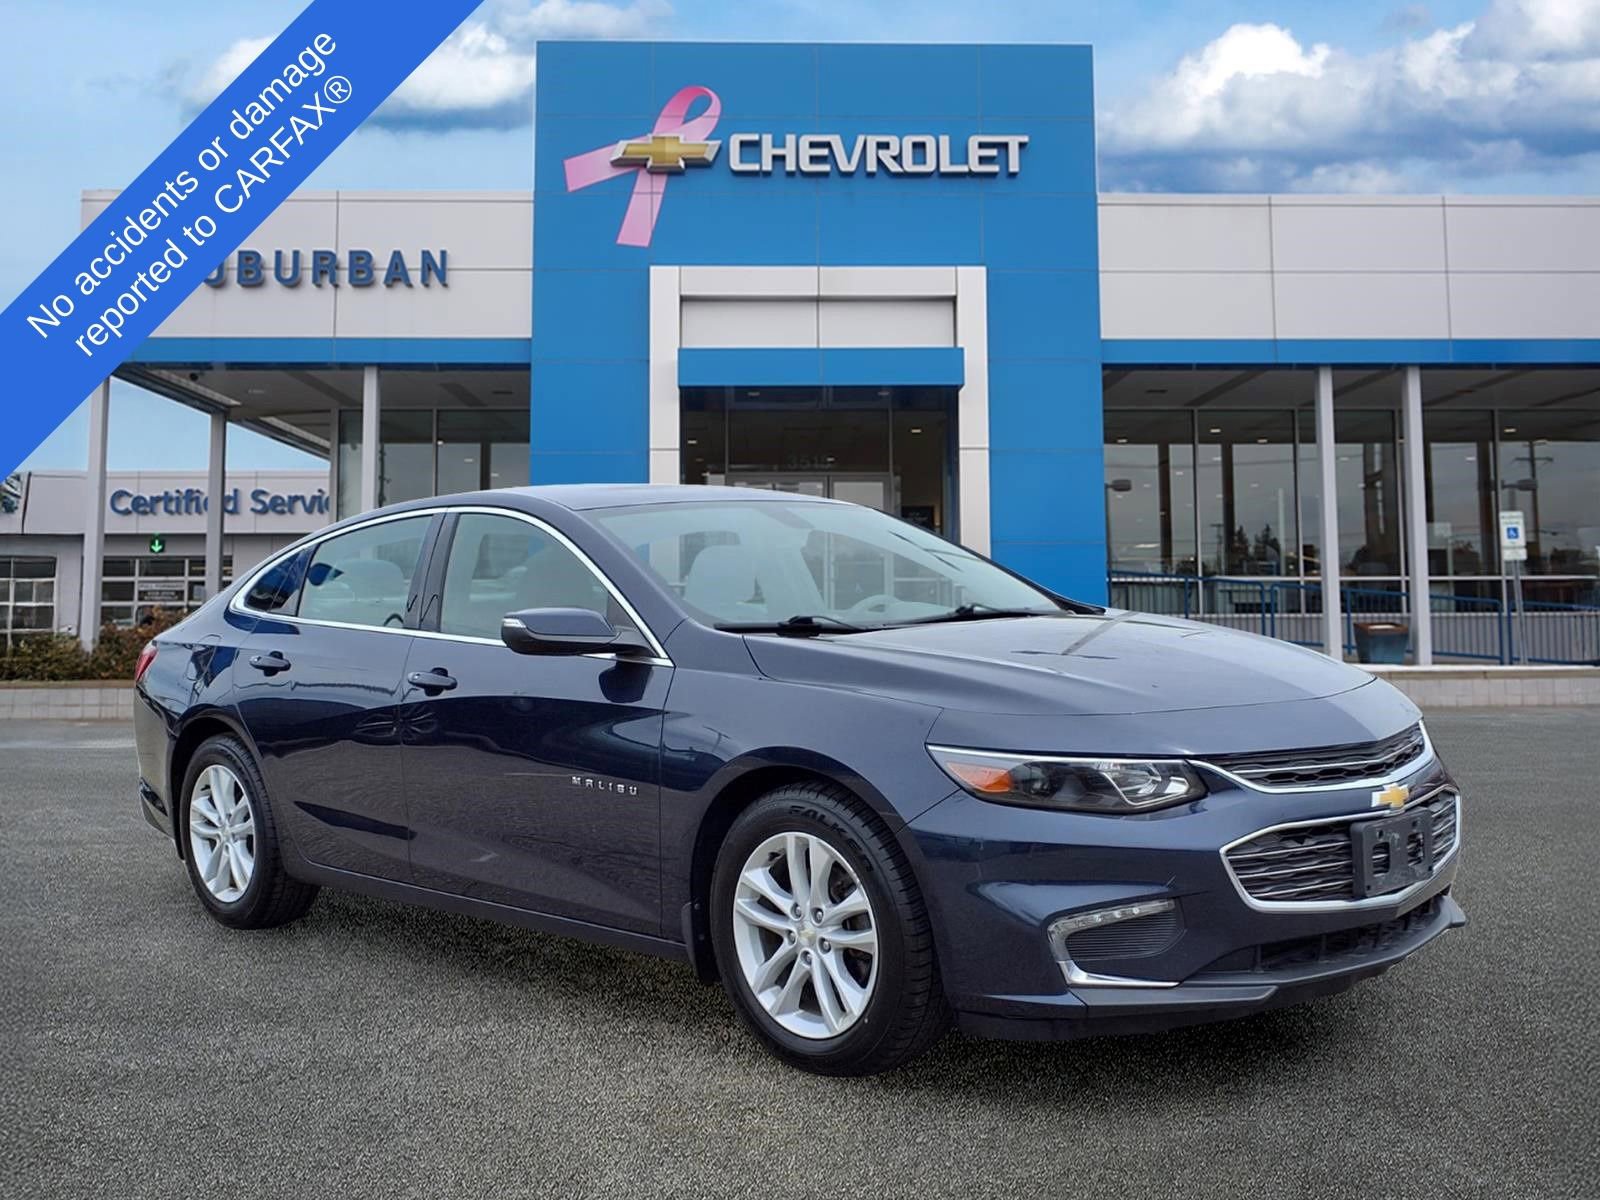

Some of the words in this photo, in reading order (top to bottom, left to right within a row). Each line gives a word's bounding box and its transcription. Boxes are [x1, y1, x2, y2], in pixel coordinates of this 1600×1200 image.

[729, 133, 1029, 174] CHEVROLET
[203, 249, 449, 287] UBURBAN
[110, 488, 240, 515] Certifid
[250, 488, 330, 515] Servi
[571, 775, 637, 796] MALIBU
